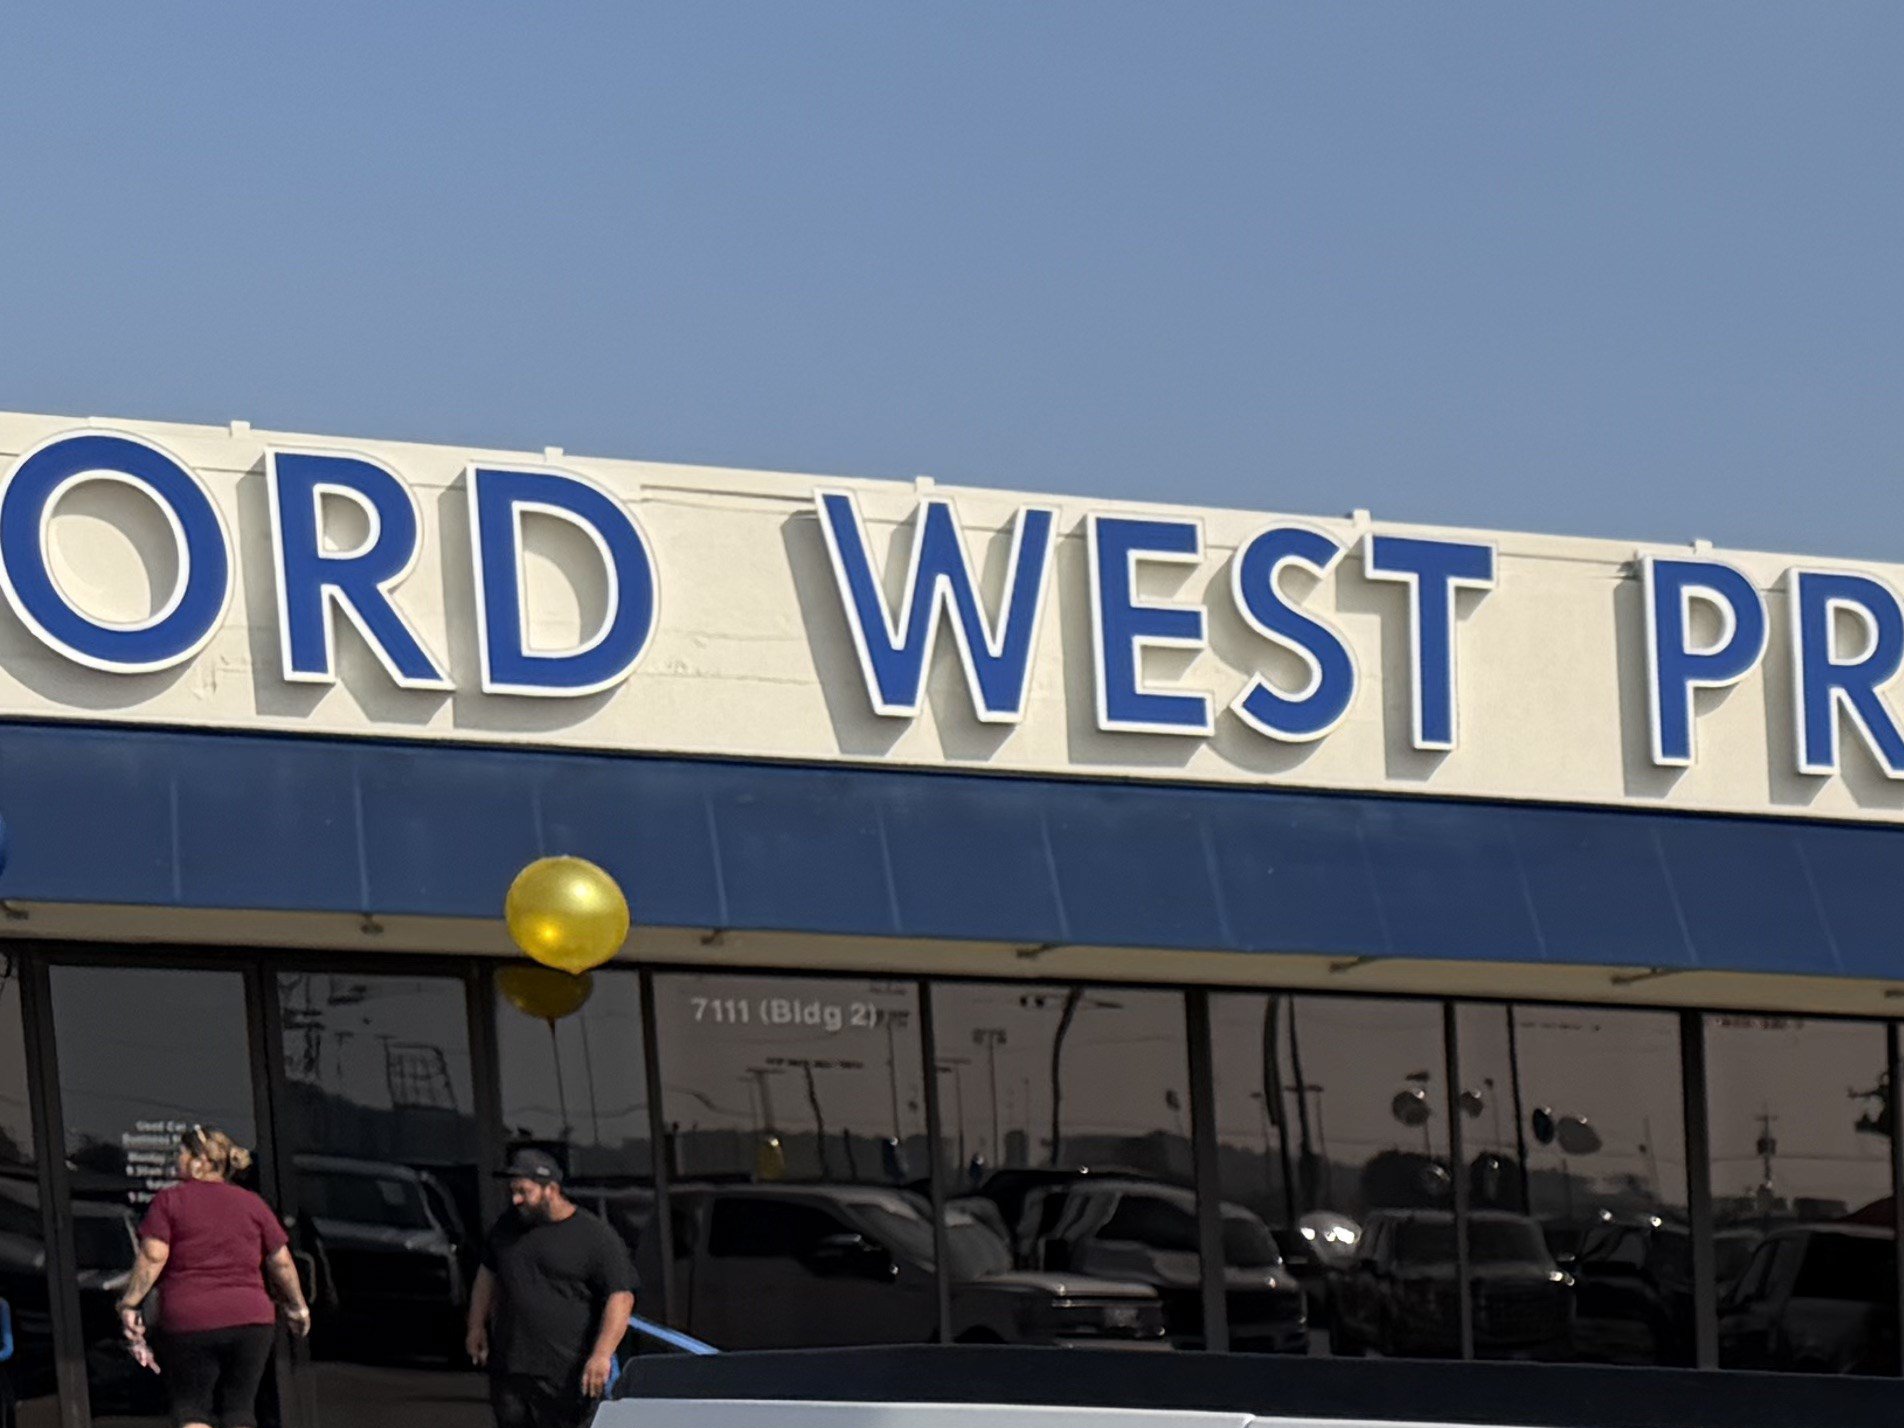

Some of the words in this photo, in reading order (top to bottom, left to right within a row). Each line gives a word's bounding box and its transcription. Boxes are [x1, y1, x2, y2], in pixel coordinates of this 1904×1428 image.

[813, 487, 1498, 752] WEST
[691, 997, 749, 1024] 7111
[760, 999, 843, 1032] (Bldg
[850, 1001, 877, 1029] 2)
